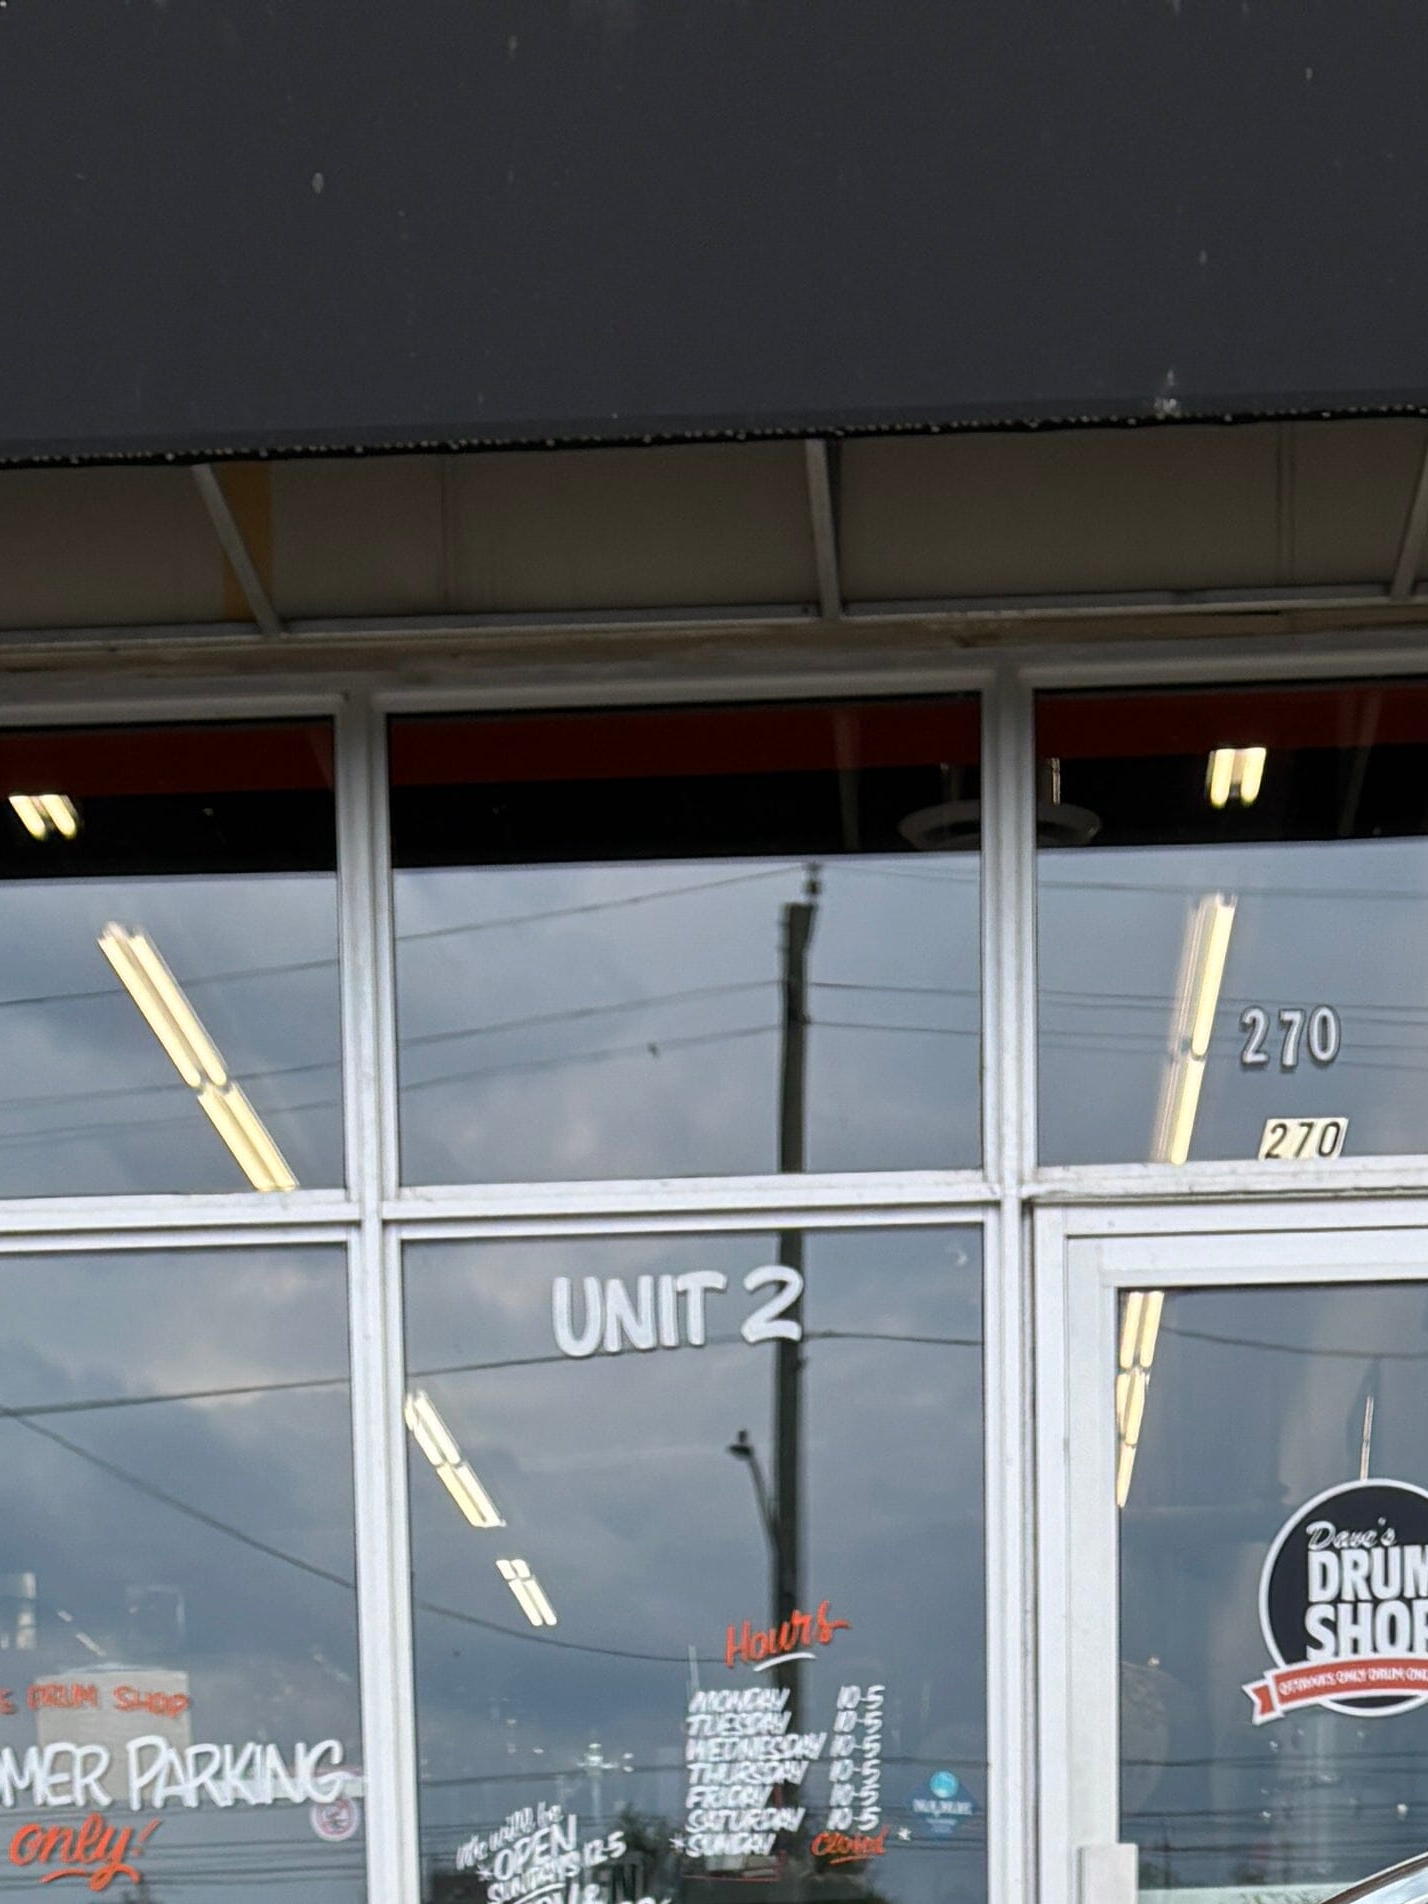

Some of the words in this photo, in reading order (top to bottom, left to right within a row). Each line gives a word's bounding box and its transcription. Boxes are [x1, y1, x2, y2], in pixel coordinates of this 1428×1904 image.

[1241, 1005, 1340, 1067] 270
[1265, 1121, 1341, 1159] 270
[551, 1269, 727, 1358] UNIT
[740, 1264, 804, 1344] 2
[1306, 1517, 1396, 1550] Dave's
[725, 1600, 851, 1670] Hours
[26, 1682, 99, 1712] DRUM
[113, 1685, 190, 1720] SHOP
[688, 1687, 791, 1712] MONDAY
[836, 1684, 885, 1710] 10-5
[686, 1711, 792, 1736] TUESDAY
[834, 1710, 883, 1734] 10-5
[685, 1731, 828, 1761] WEDNESDAY
[830, 1733, 882, 1758] 10-5
[127, 1735, 350, 1812] PARKING
[686, 1760, 810, 1785] THURSDAY
[829, 1759, 881, 1786] 10-5
[686, 1785, 775, 1809] FRIDAY
[829, 1783, 880, 1807] 10-5
[685, 1807, 806, 1833] SATURDAY
[827, 1807, 881, 1831] 10-5
[9, 1813, 160, 1892] only!
[494, 1814, 578, 1881] OPEN
[686, 1832, 776, 1858] SUNDAY
